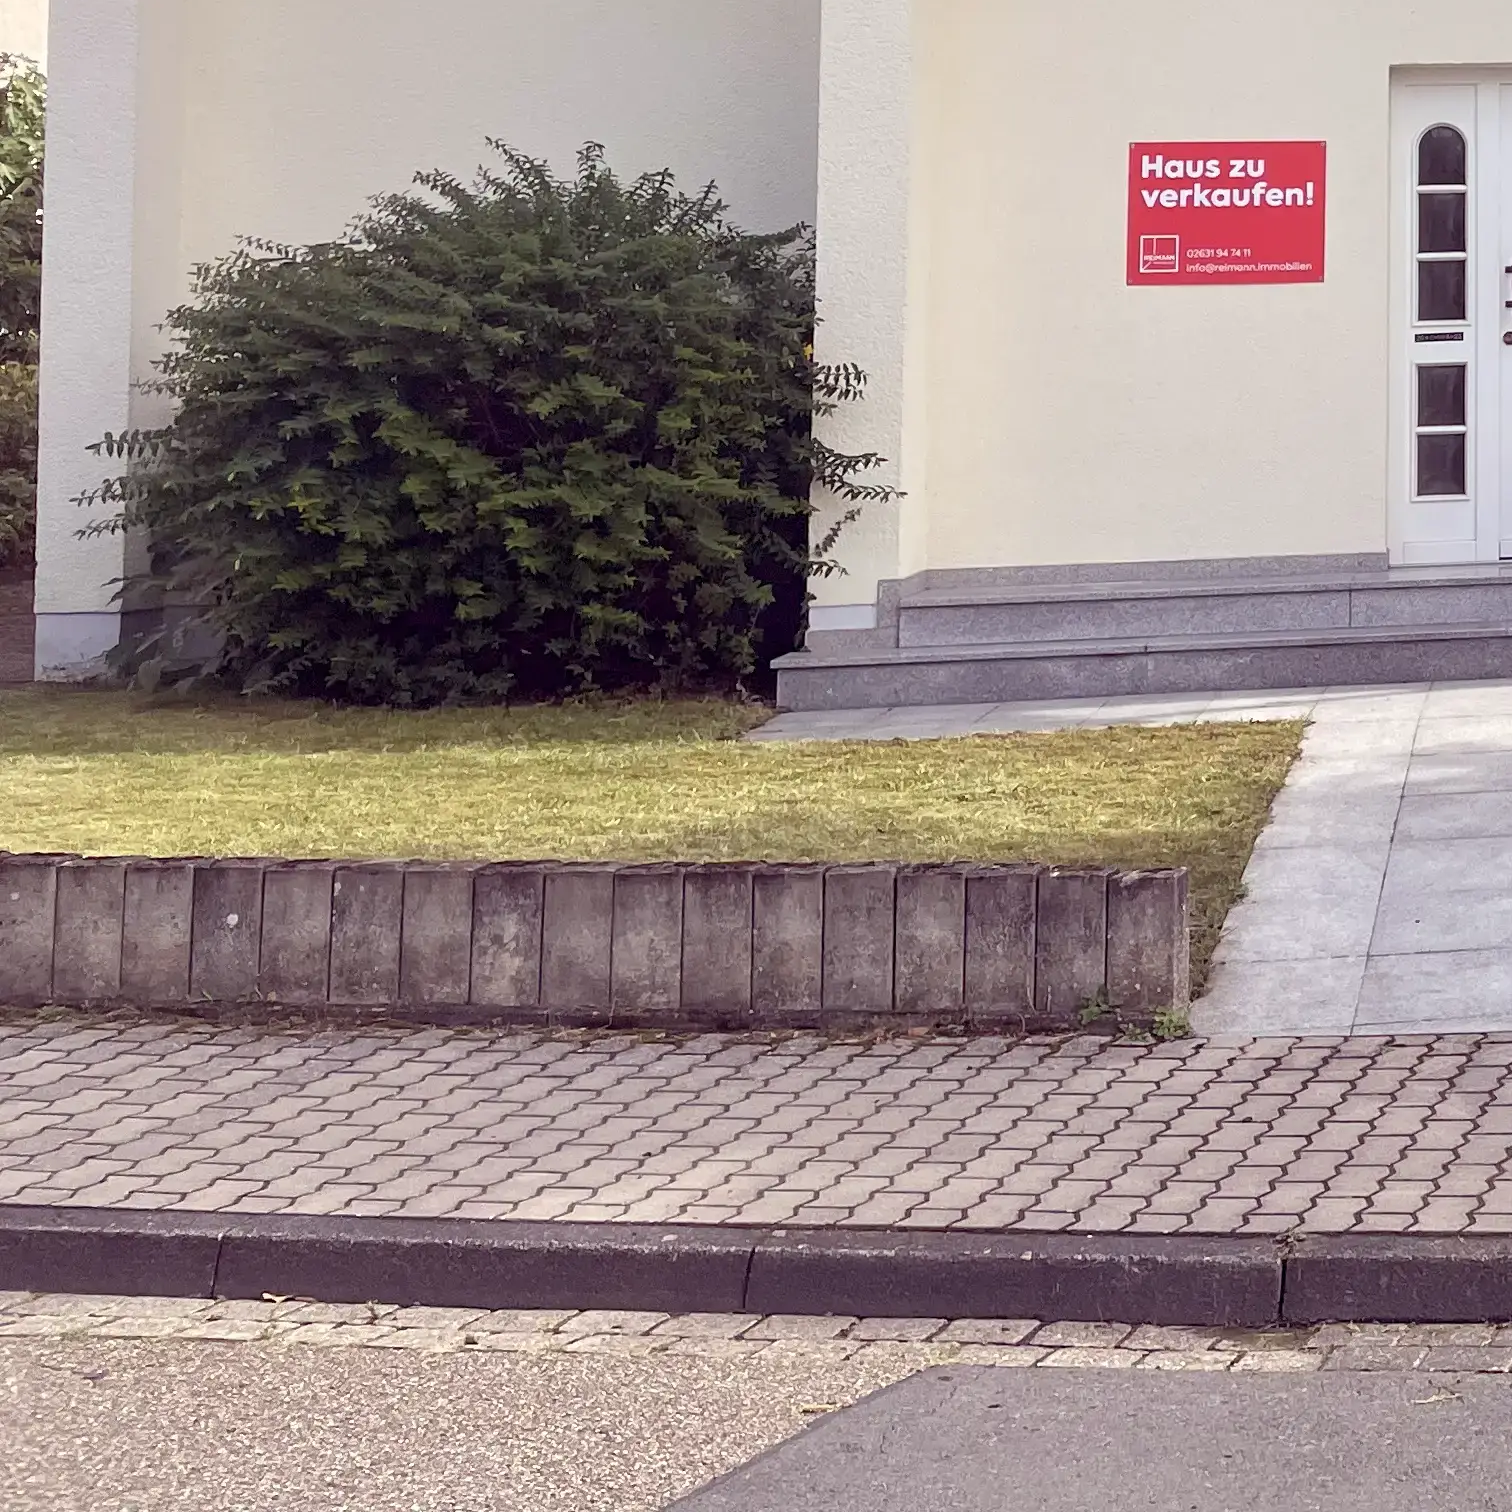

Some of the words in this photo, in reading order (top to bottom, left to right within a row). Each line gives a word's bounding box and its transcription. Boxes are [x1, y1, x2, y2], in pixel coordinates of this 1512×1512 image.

[1141, 154, 1220, 178] Haus
[1228, 159, 1265, 178] zu
[1141, 181, 1314, 207] verkaufen!
[1186, 248, 1214, 258] 02631
[1215, 248, 1228, 258] 94
[1230, 248, 1241, 257] 74
[1243, 248, 1251, 257] 11
[1186, 262, 1312, 274] info@reimann.immobilien
